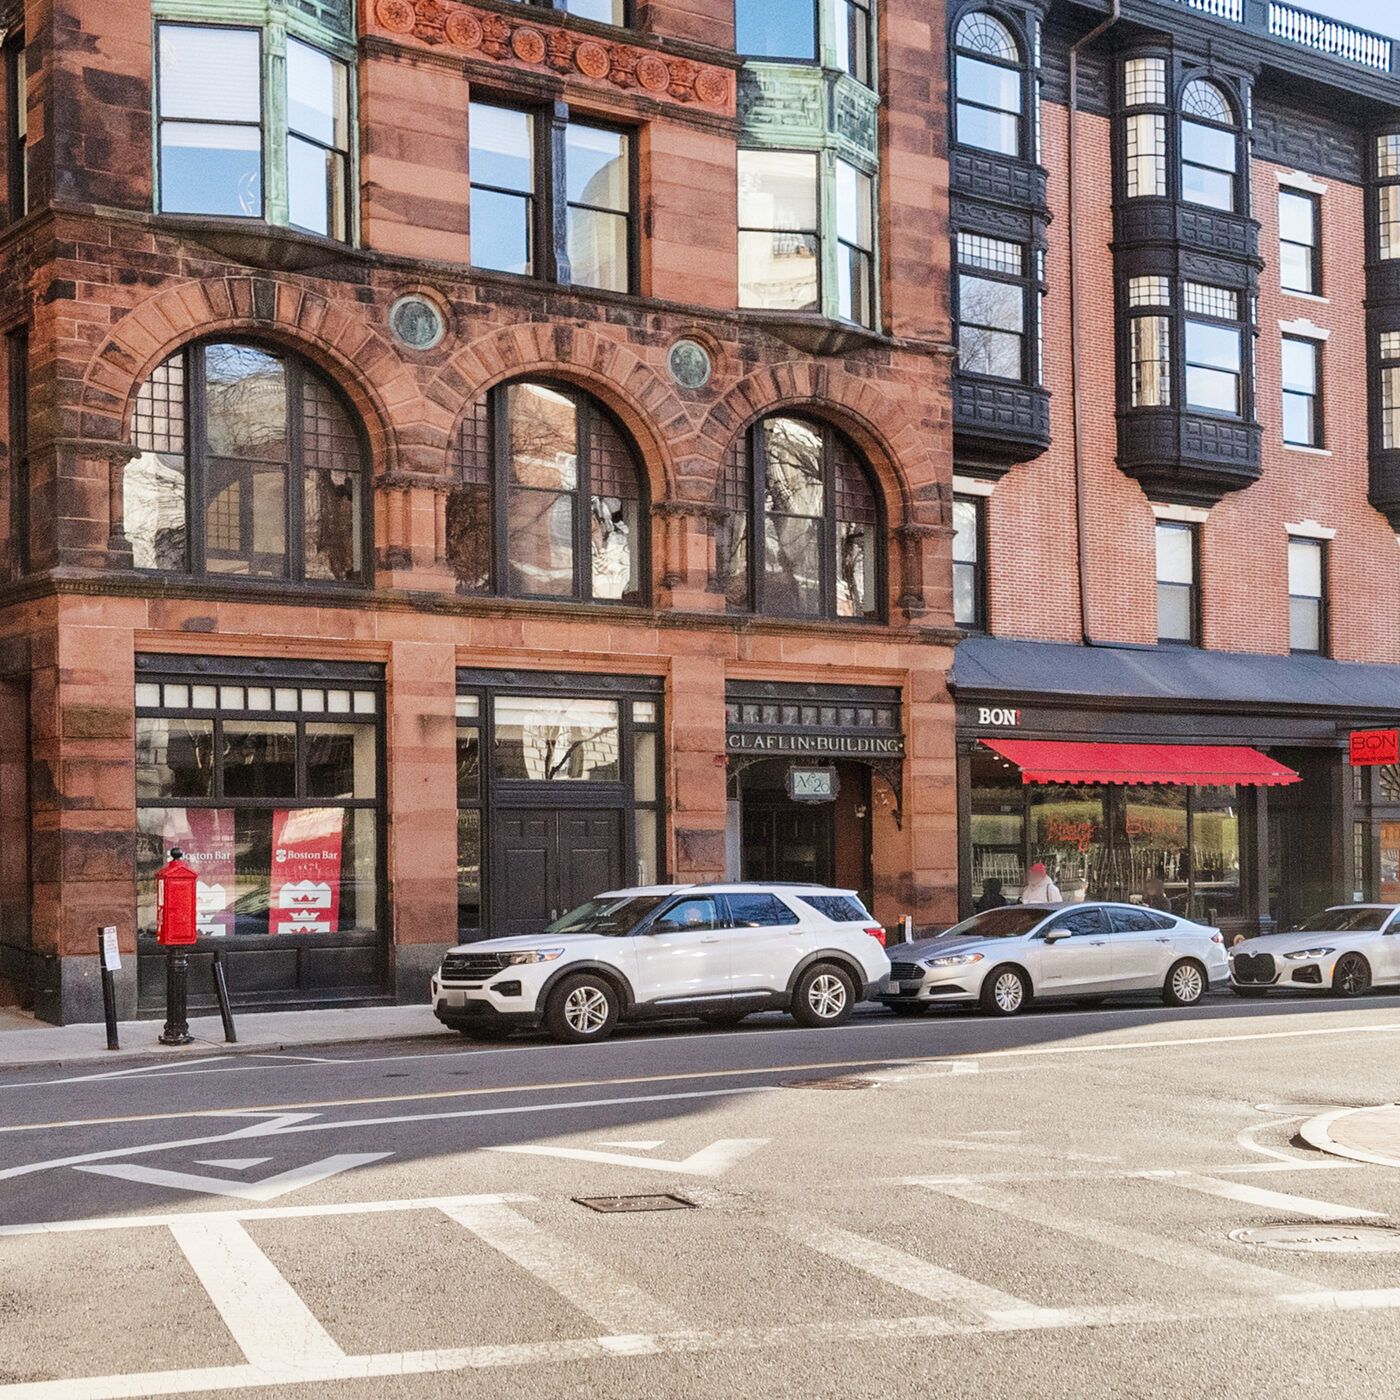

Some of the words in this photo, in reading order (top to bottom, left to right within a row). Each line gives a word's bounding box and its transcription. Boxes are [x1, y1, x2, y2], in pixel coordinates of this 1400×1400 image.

[813, 778, 831, 793] 20
[215, 850, 231, 860] Bar
[287, 850, 321, 860] Boston
[322, 850, 338, 860] Bar
